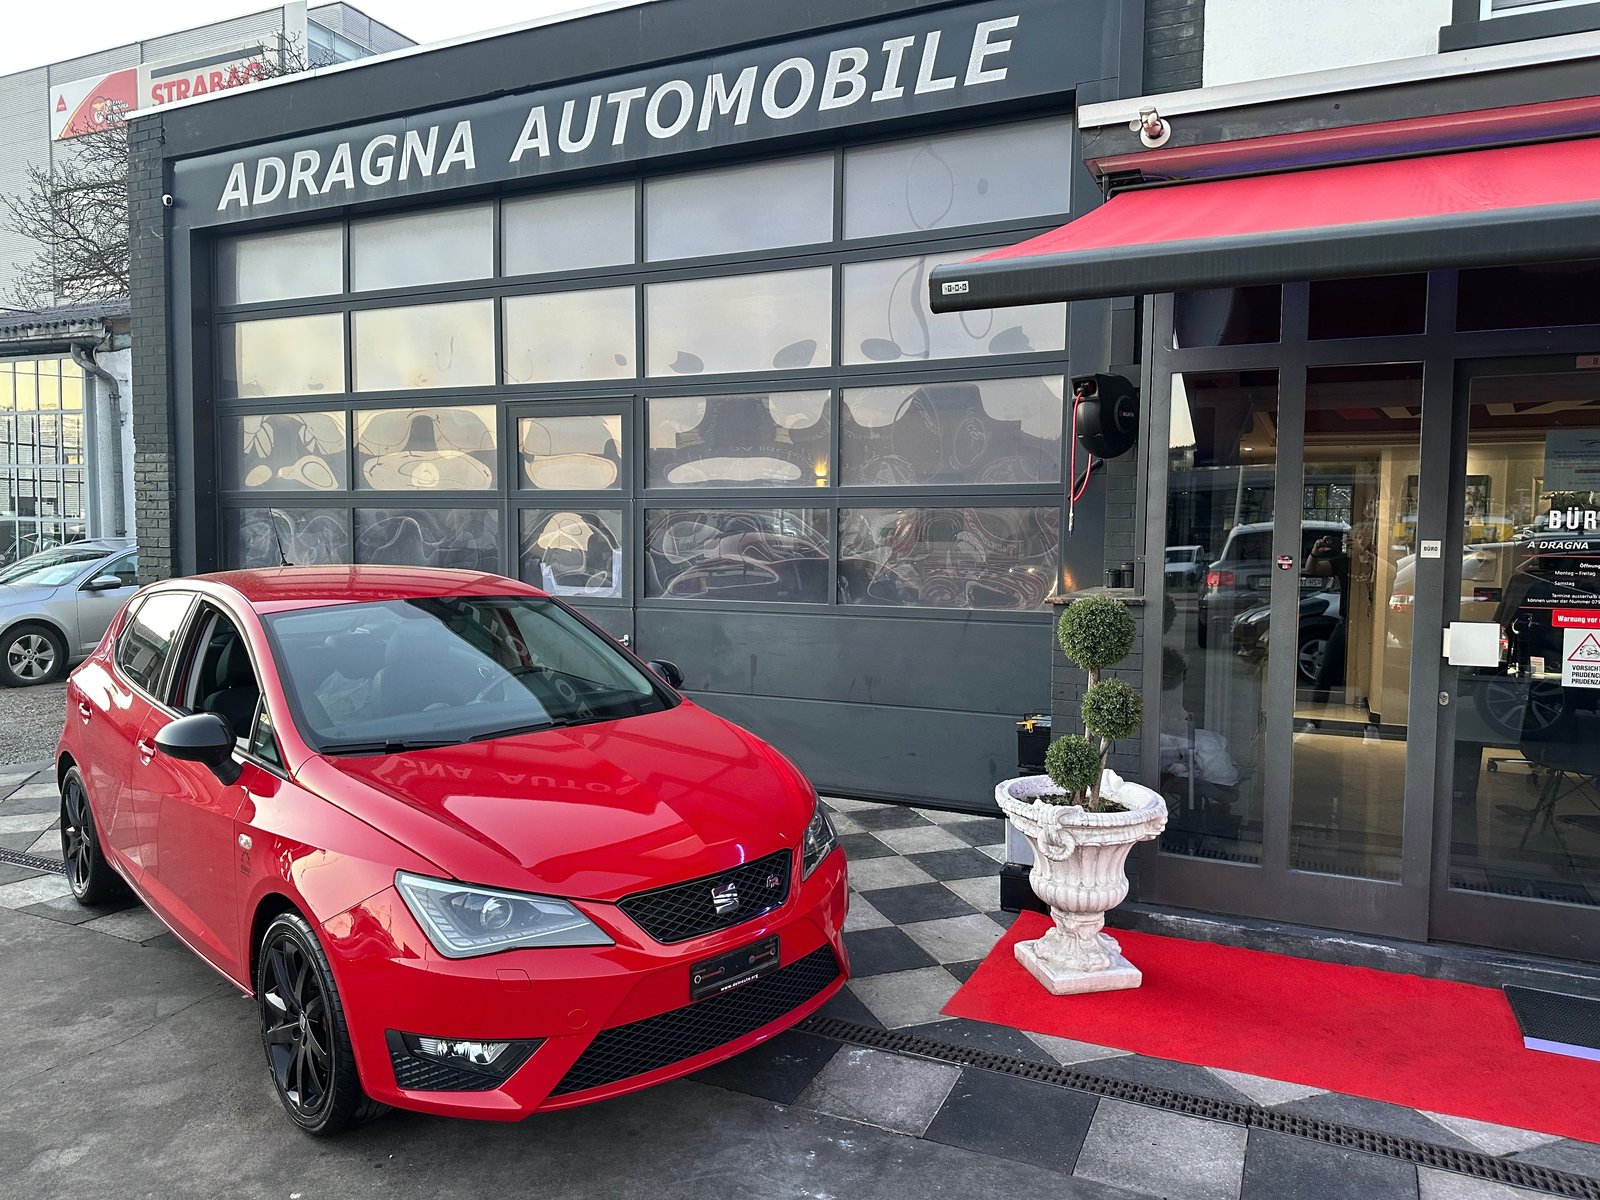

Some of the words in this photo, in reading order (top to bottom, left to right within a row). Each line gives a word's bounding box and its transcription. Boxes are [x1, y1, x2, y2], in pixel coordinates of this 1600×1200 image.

[216, 121, 476, 211] ADRAGNA
[508, 15, 1020, 163] AUTOMOBILE
[1557, 615, 1586, 624] Warnung
